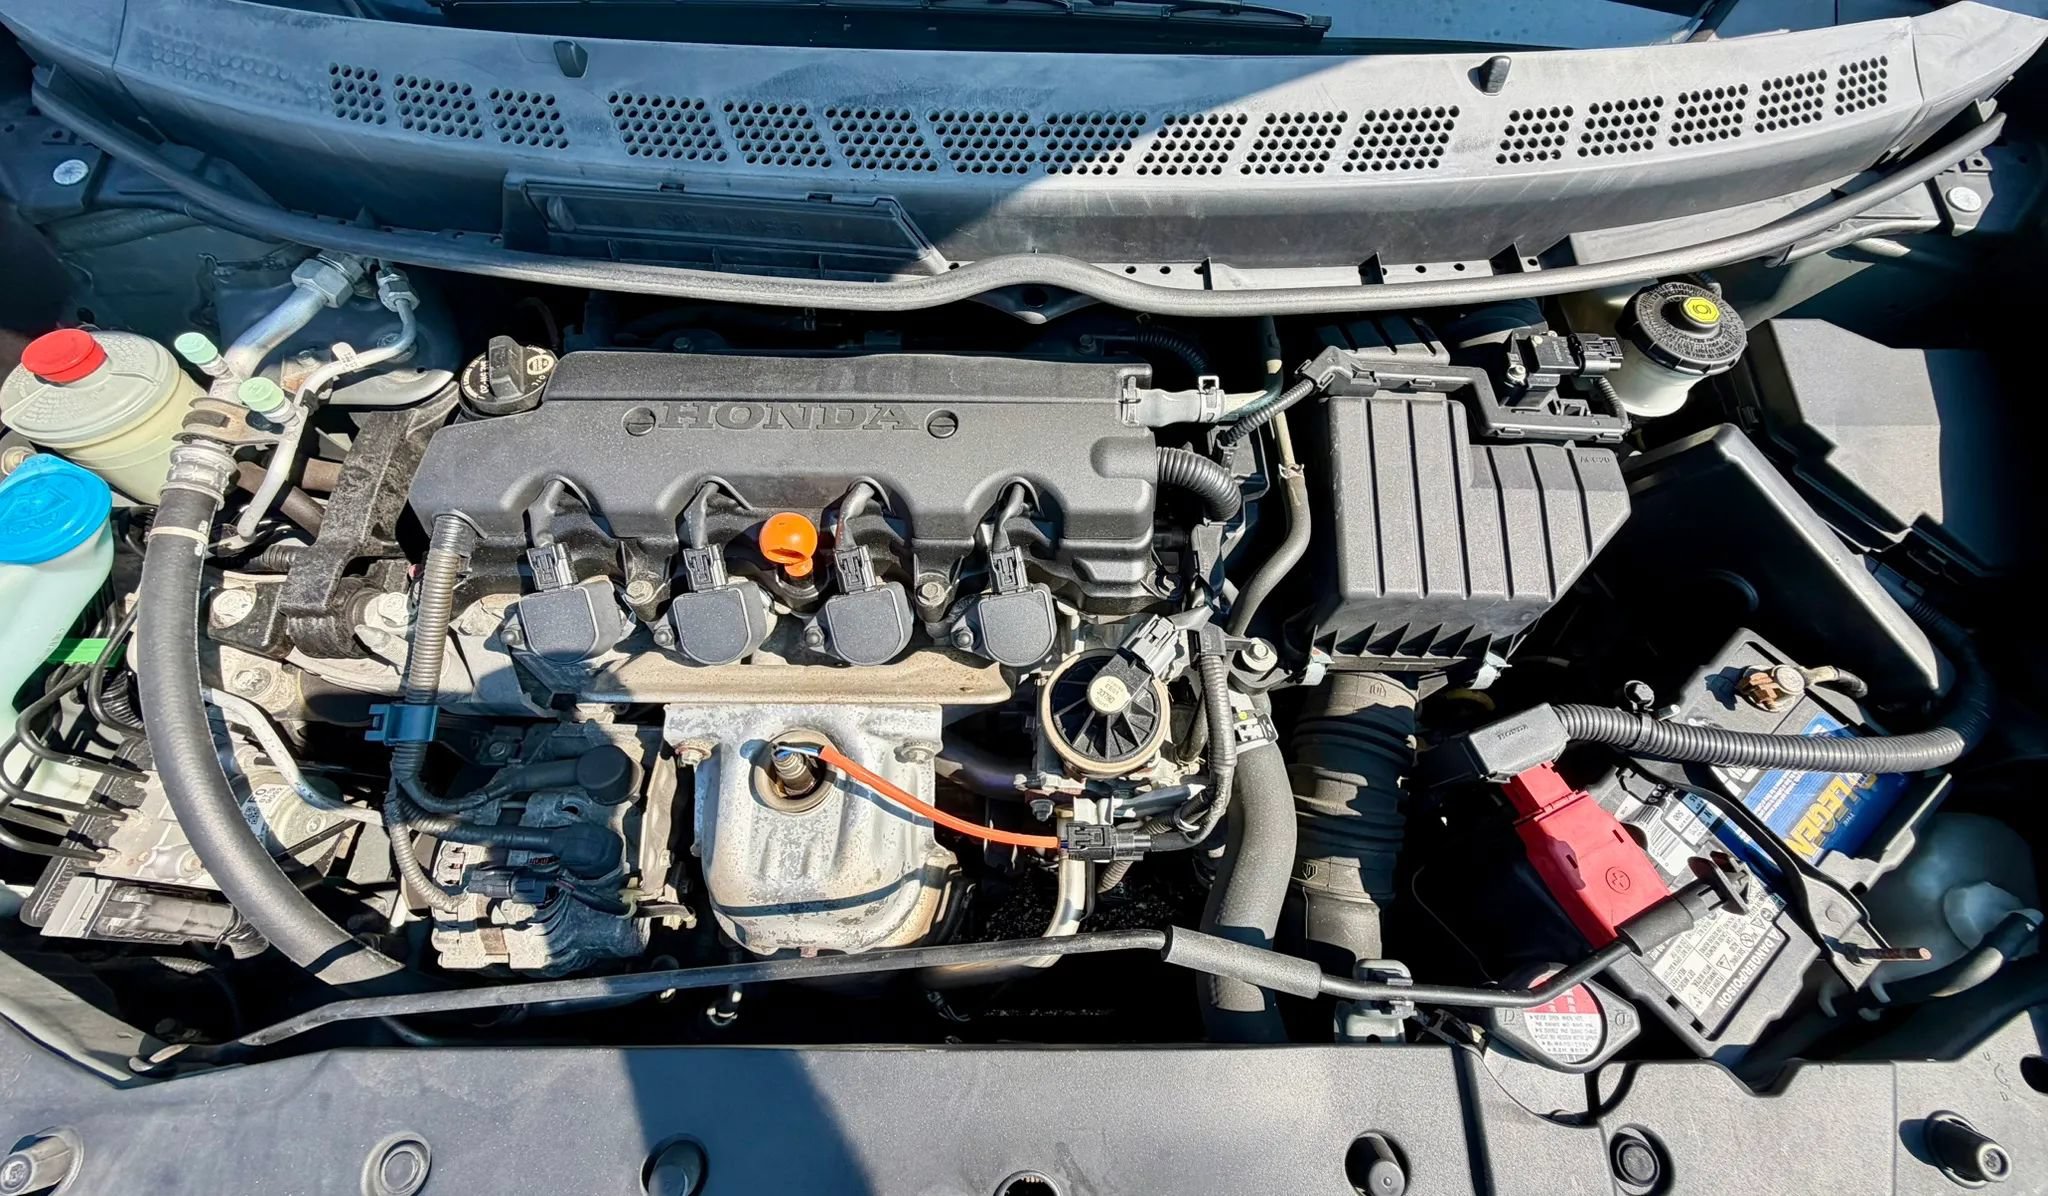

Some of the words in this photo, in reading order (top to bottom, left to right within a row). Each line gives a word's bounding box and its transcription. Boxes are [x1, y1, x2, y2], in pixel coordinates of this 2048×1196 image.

[531, 375, 545, 385] OIL
[658, 402, 920, 430] HONDA
[1717, 940, 1774, 1008] DANGER/POISON
